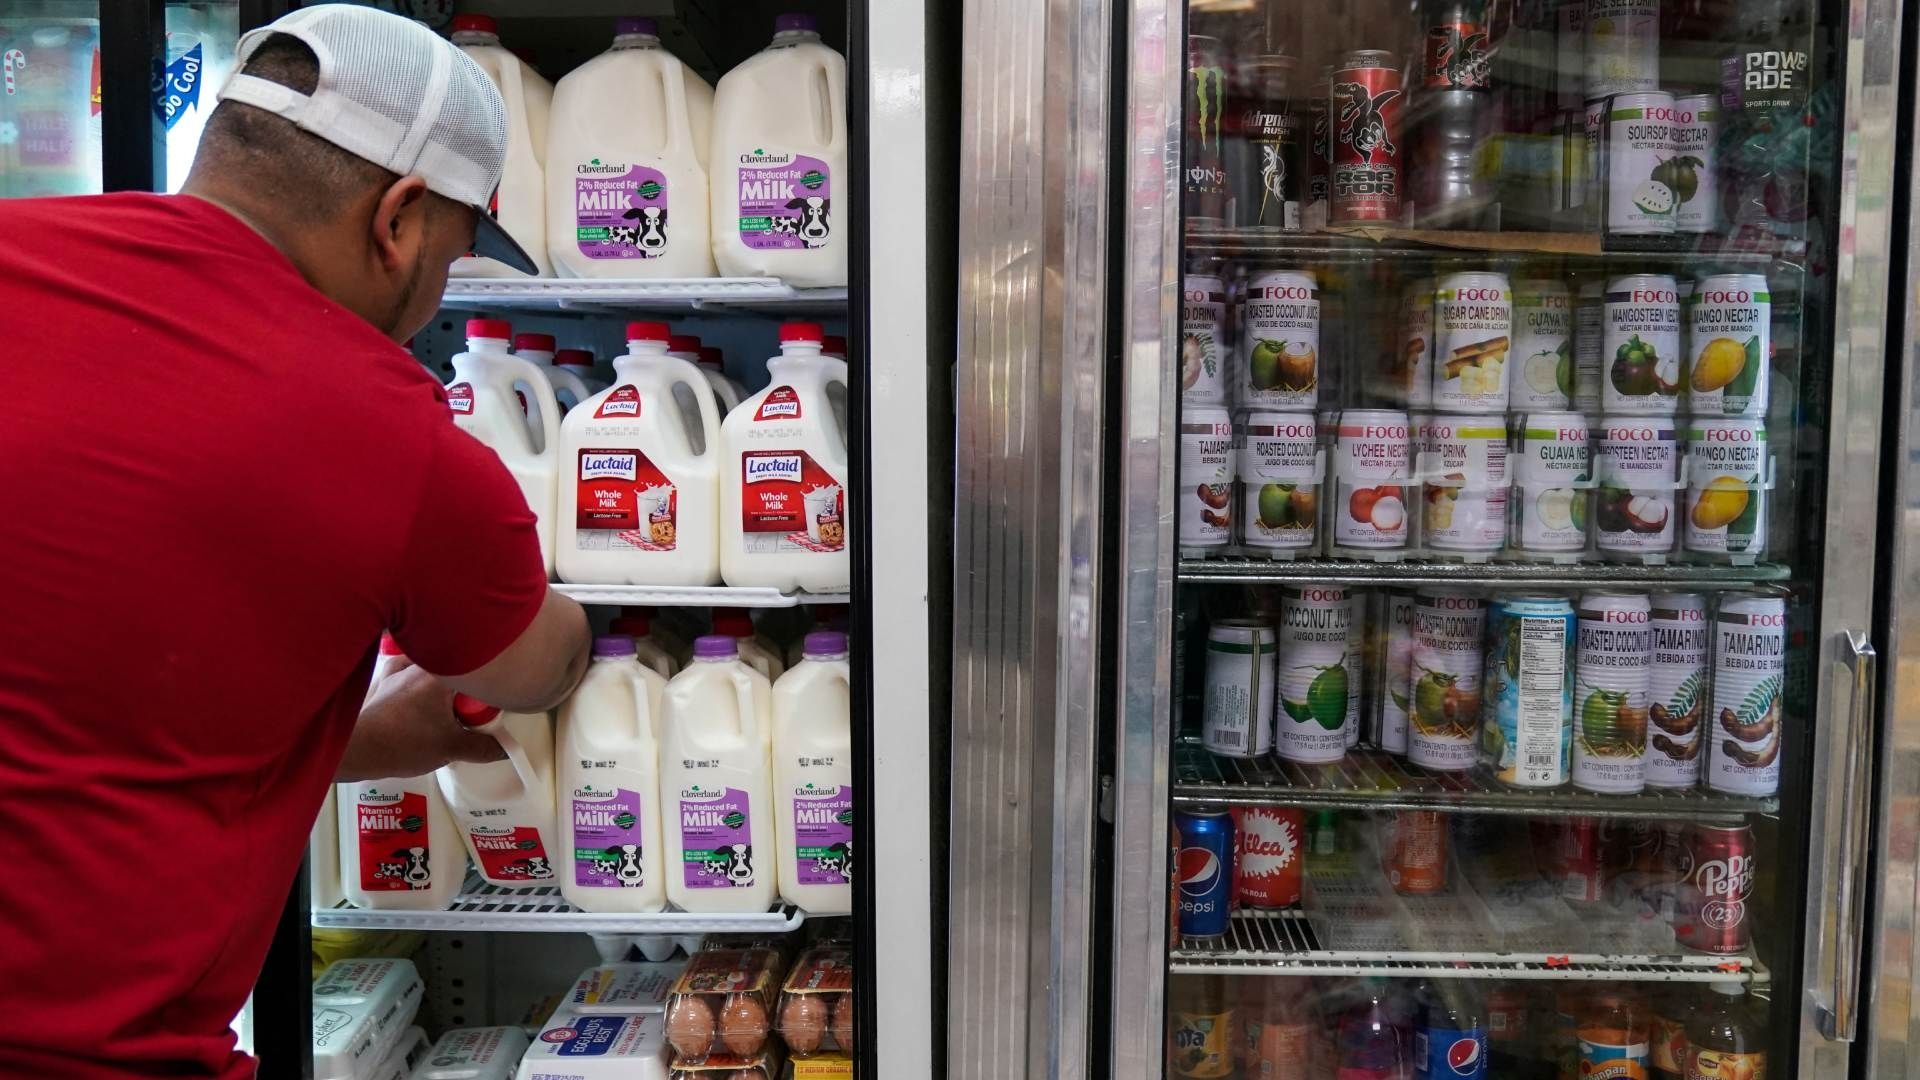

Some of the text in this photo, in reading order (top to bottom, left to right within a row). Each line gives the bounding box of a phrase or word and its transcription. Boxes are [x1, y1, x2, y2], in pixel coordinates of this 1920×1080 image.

[174, 55, 202, 93] Cool
[1745, 71, 1793, 90] ADE
[1263, 128, 1290, 136] RUSH
[1628, 126, 1668, 140] SOURSOP
[741, 154, 788, 164] Cloverland
[577, 163, 625, 173] Cloverland
[741, 170, 801, 180] 2% Reduced Fat
[578, 180, 638, 190] 2% Reduced Fat
[742, 179, 796, 200] Milk
[1336, 184, 1396, 196] TOR
[578, 190, 632, 210] Milk
[1184, 291, 1205, 303] CO
[1265, 286, 1308, 300] FOCO
[1457, 288, 1500, 302] FOCO
[1634, 290, 1675, 303] FOCO
[1704, 290, 1749, 304] FOCO
[1192, 306, 1217, 321] DRINK
[1248, 304, 1275, 319] ROASTED
[1275, 303, 1306, 320] COCONUT
[1443, 306, 1511, 320] SUGAR CANE DRINK
[1612, 308, 1664, 322] MANGOSTEEN
[1694, 309, 1759, 323] MANGO NECTAR
[1527, 312, 1560, 326] GUAVA
[605, 402, 636, 410] Lactaid
[764, 403, 796, 412] Lactaid
[1276, 425, 1314, 438] FOCO
[1366, 426, 1406, 439] FOCO
[1609, 429, 1654, 442] FOCO
[1706, 429, 1752, 442] FOCO
[1256, 442, 1286, 457] ROASTED
[1352, 444, 1386, 458] LYCHEE
[1442, 444, 1467, 459] DRINK
[1540, 446, 1574, 460] GUAVA
[1641, 446, 1670, 461] NECTAR
[1695, 446, 1760, 461] MANGO NECTAR
[585, 456, 634, 471] Lactaid
[749, 458, 799, 473] Lactaid
[1264, 459, 1305, 467] JUGO DE COCO
[1385, 460, 1393, 468] DE
[1725, 463, 1756, 471] DE MANGO
[595, 489, 622, 499] Whole
[760, 492, 789, 501] Whole
[599, 499, 617, 508] Milk
[765, 501, 784, 510] Milk
[1303, 588, 1342, 602] FOCO
[1436, 597, 1476, 610] FOCO
[1282, 605, 1333, 630] COCONUT
[1606, 610, 1648, 623] FOCO
[1415, 612, 1480, 641] ROASTED COCONUT
[1294, 633, 1347, 644] JUGO DE COCO
[1581, 628, 1648, 655] ROASTED COCONUT
[1653, 627, 1704, 654] TAMARIND
[1437, 640, 1447, 649] DE
[1447, 640, 1469, 651] COCO
[1723, 632, 1776, 660] TAMARIND
[1584, 655, 1640, 667] JUGO DE COCO
[1656, 653, 1695, 665] BEBIDA DE
[1726, 657, 1768, 669] BEBIDA DE
[360, 792, 400, 802] Cloverland
[574, 789, 614, 798] Cloverland
[681, 789, 721, 798] Cloverland
[795, 787, 837, 796] Cloverland
[361, 807, 393, 815] Vitamin
[586, 803, 616, 811] Reduced
[796, 800, 852, 809] 2% Reduced Fat
[361, 814, 403, 831] Milk
[576, 810, 617, 826] Milk
[683, 811, 725, 827] Milk
[797, 809, 838, 824] Milk
[471, 826, 512, 835] Cloverland
[474, 835, 507, 843] Vitamin
[476, 840, 519, 851] Milk
[1728, 855, 1752, 879] Dr
[1249, 890, 1267, 898] ROJA
[1178, 899, 1215, 914] pepsi
[1714, 907, 1734, 921] 23
[592, 1027, 615, 1044] BEST
